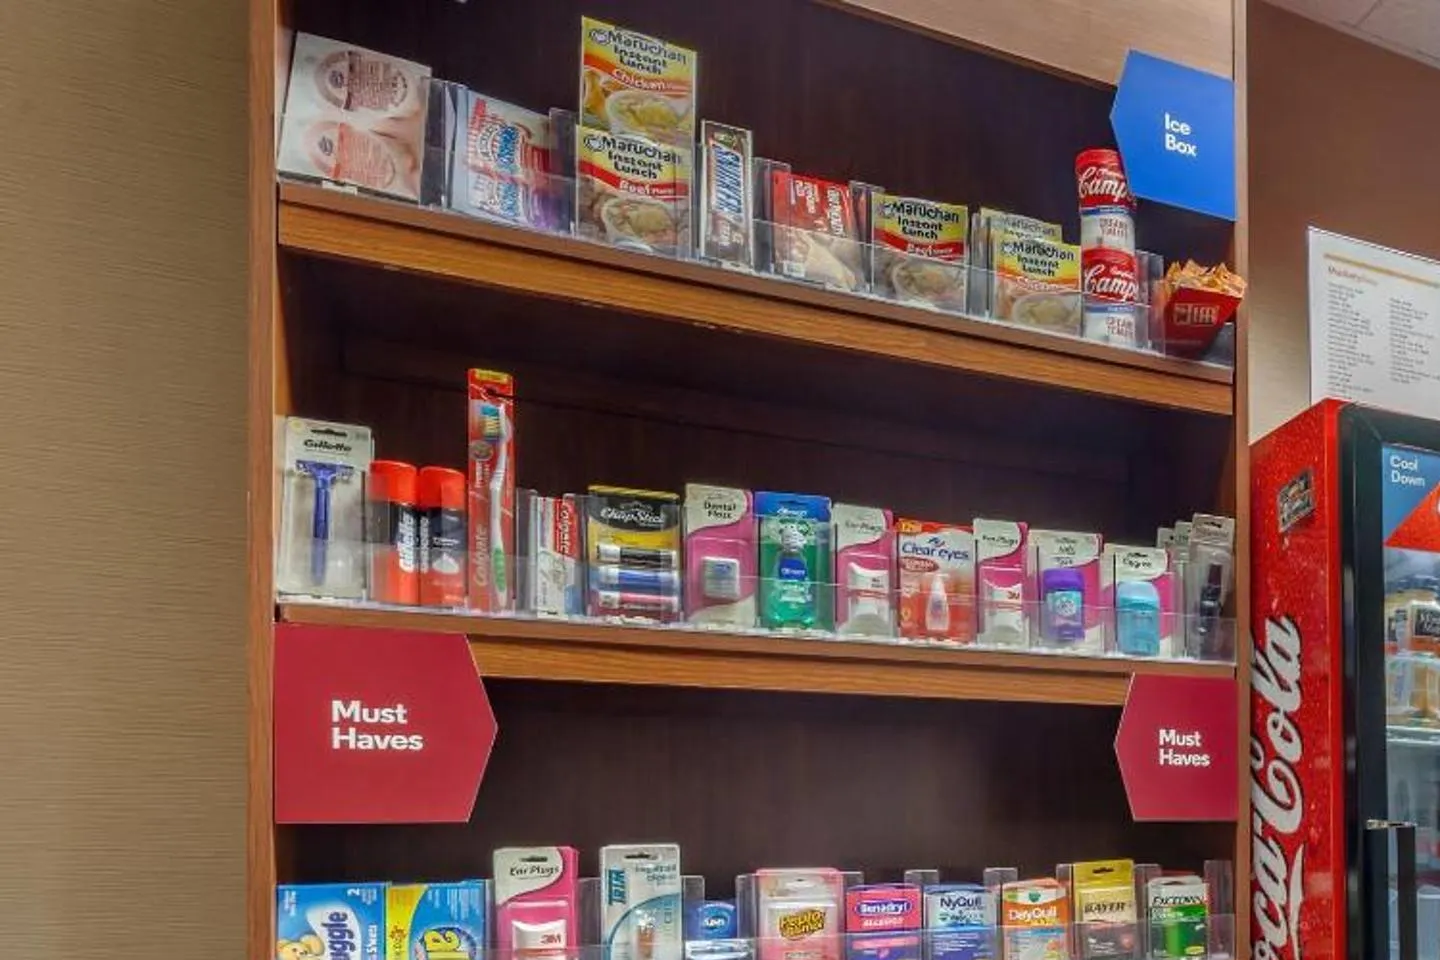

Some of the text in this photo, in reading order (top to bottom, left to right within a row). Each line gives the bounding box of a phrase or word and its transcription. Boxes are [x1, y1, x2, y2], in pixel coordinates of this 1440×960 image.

[607, 29, 687, 64] Maruchan
[614, 45, 667, 68] Instant
[619, 55, 662, 75] Lunch
[1164, 113, 1191, 135] Ice
[602, 135, 682, 165] Maruchan
[1165, 133, 1197, 157] Box
[608, 151, 663, 172] Instant
[614, 162, 657, 180] Lunch
[892, 202, 960, 224] Maruchan
[898, 216, 944, 231] Instant
[902, 226, 938, 240] Lunch
[1013, 239, 1075, 261] Maruchan
[1017, 254, 1060, 269] Instant
[1022, 264, 1056, 278] Lunch
[1390, 455, 1418, 472] Cool
[1391, 470, 1426, 487] Down
[704, 501, 736, 512] Dental
[707, 509, 732, 520] Floss
[557, 501, 571, 555] Colgate
[902, 541, 969, 561] Clear eyes
[332, 700, 408, 723] Must
[332, 727, 424, 750] Haves
[1159, 729, 1202, 747] Must
[1159, 749, 1211, 766] Haves
[529, 864, 560, 877] Plugs
[940, 896, 982, 910] NyQuil
[1084, 902, 1126, 913] BAYER
[1009, 906, 1057, 922] DayQuil
[541, 933, 562, 945] 3M
